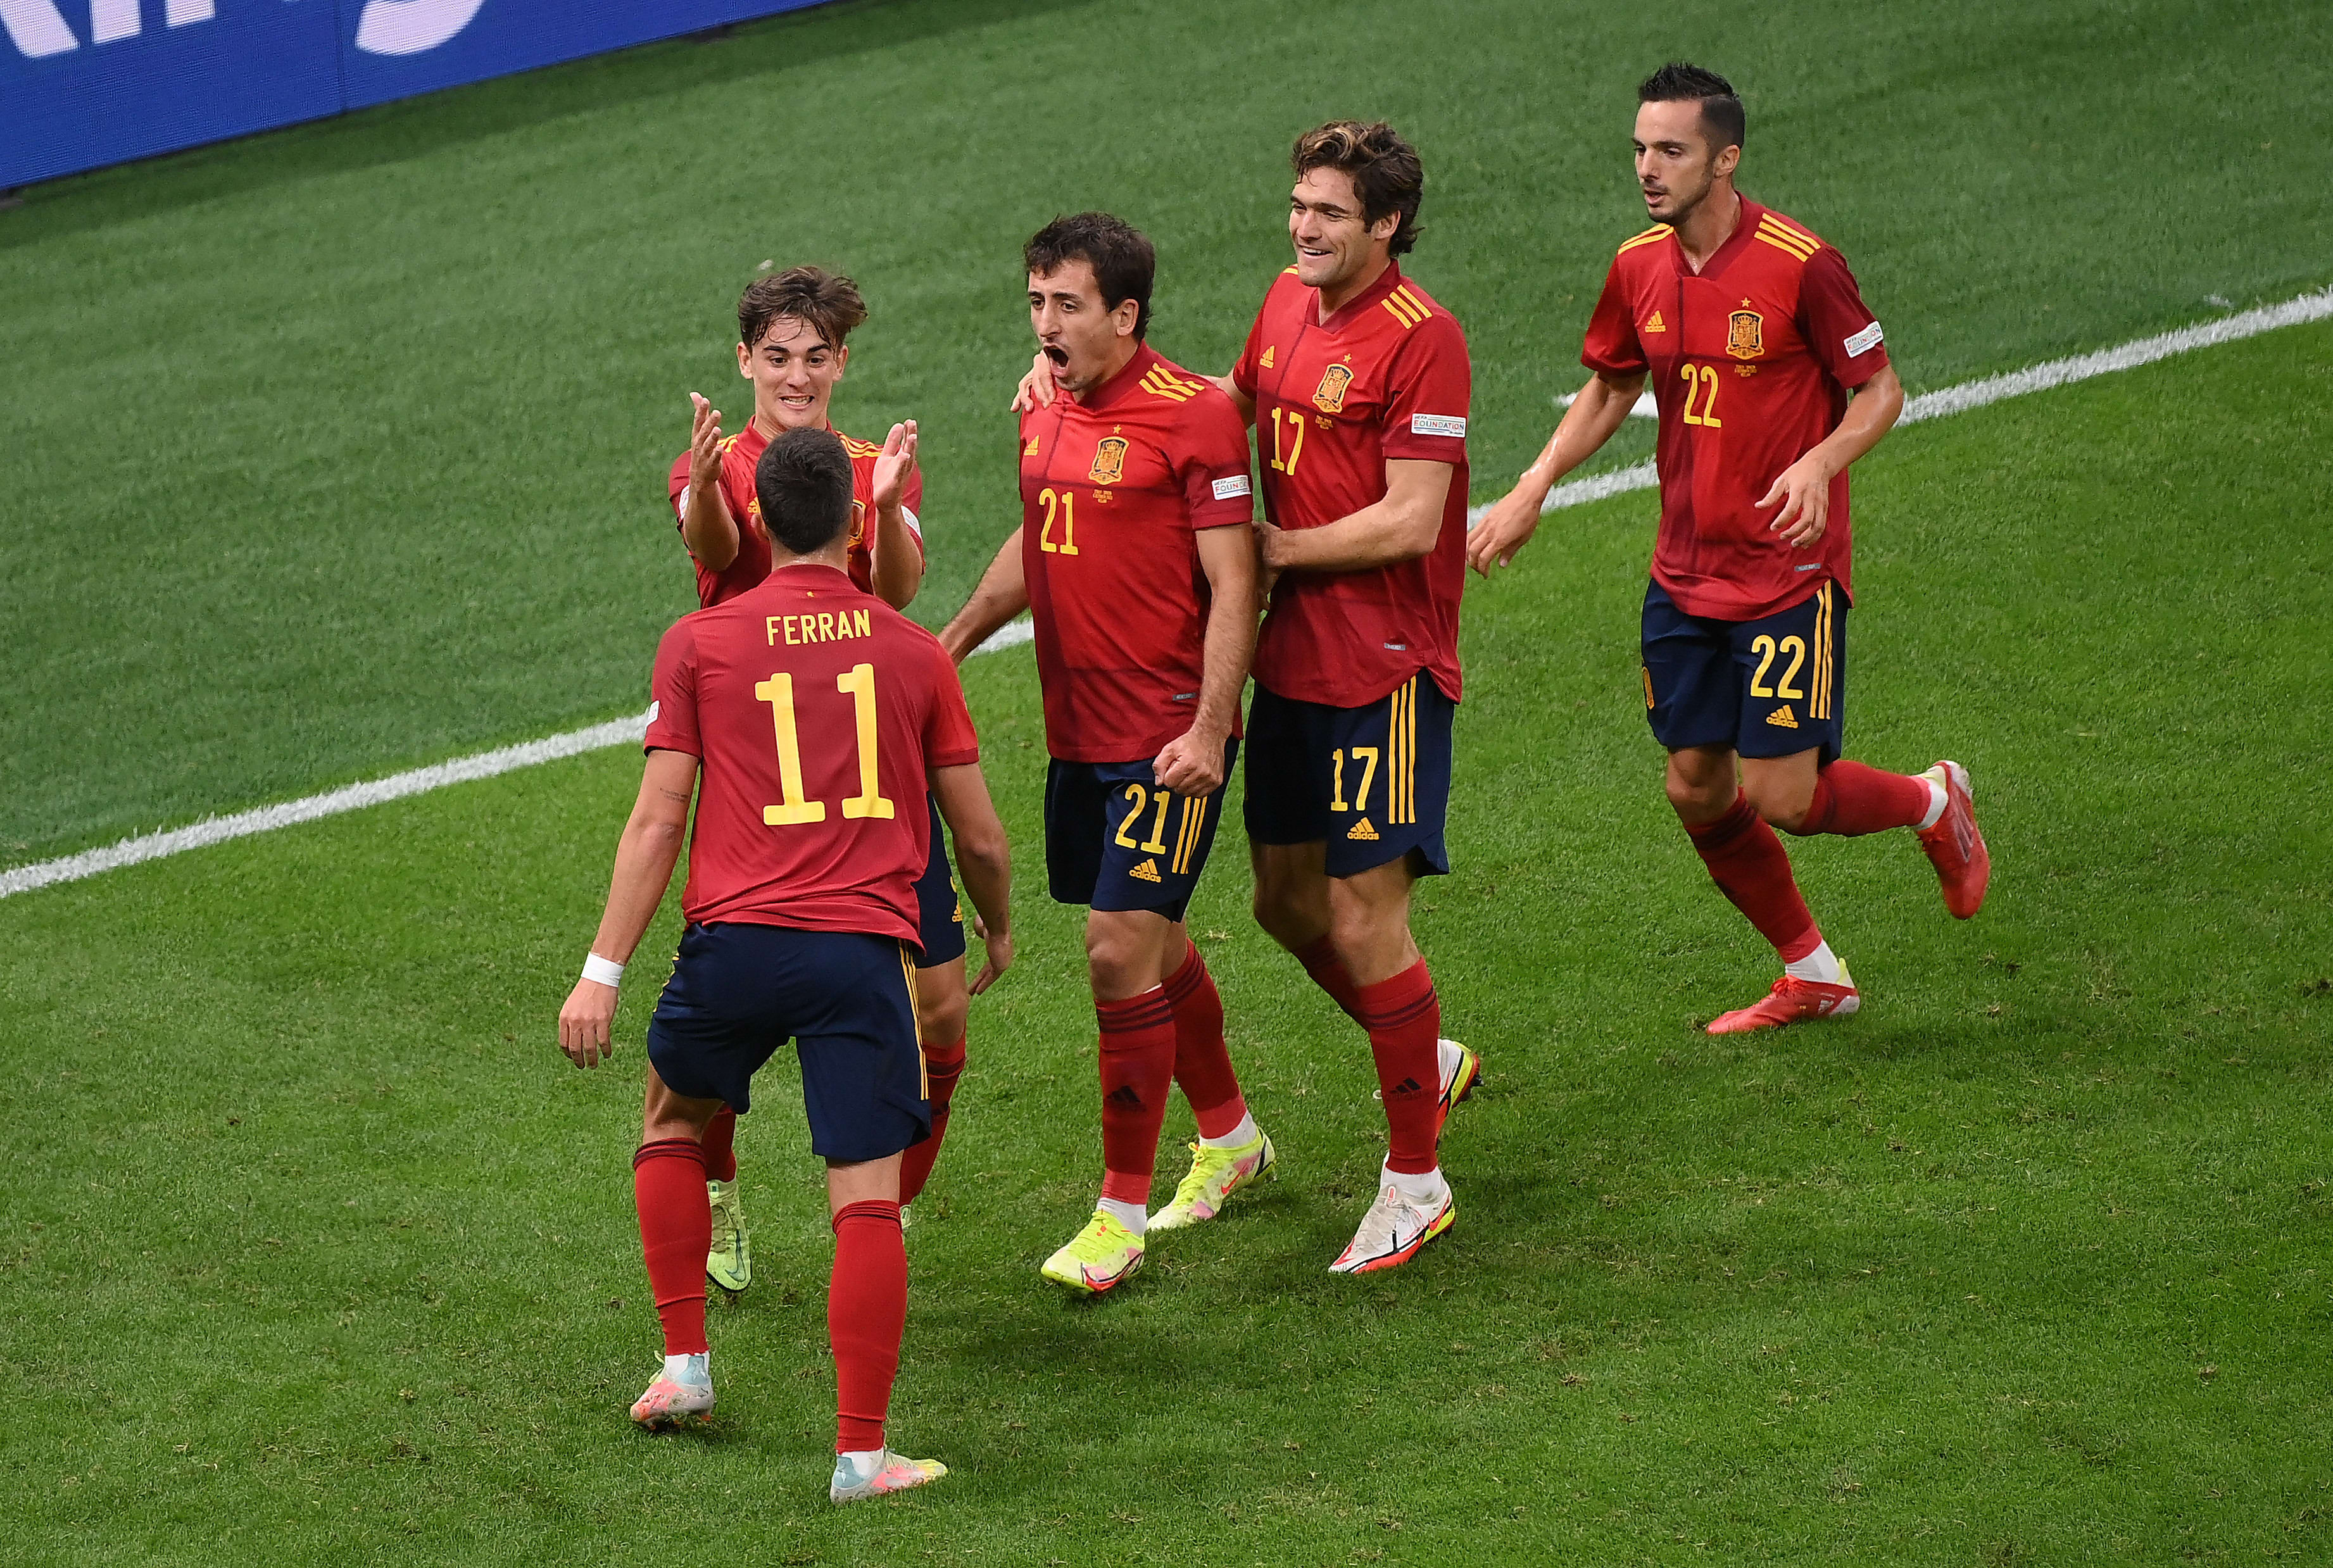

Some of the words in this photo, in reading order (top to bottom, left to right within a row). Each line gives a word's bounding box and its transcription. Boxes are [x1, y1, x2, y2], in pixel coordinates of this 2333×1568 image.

[1413, 420, 1464, 430] FOUNDATION
[1681, 363, 1722, 428] 22
[1271, 407, 1304, 476] 17
[1039, 487, 1079, 556] 21
[766, 608, 872, 646] FERRAN
[1751, 634, 1806, 699] 22
[755, 663, 895, 826] 11
[1331, 747, 1379, 812] 17
[1115, 783, 1171, 855] 21
[1347, 831, 1380, 841] adidas
[1129, 869, 1162, 883] adidas
